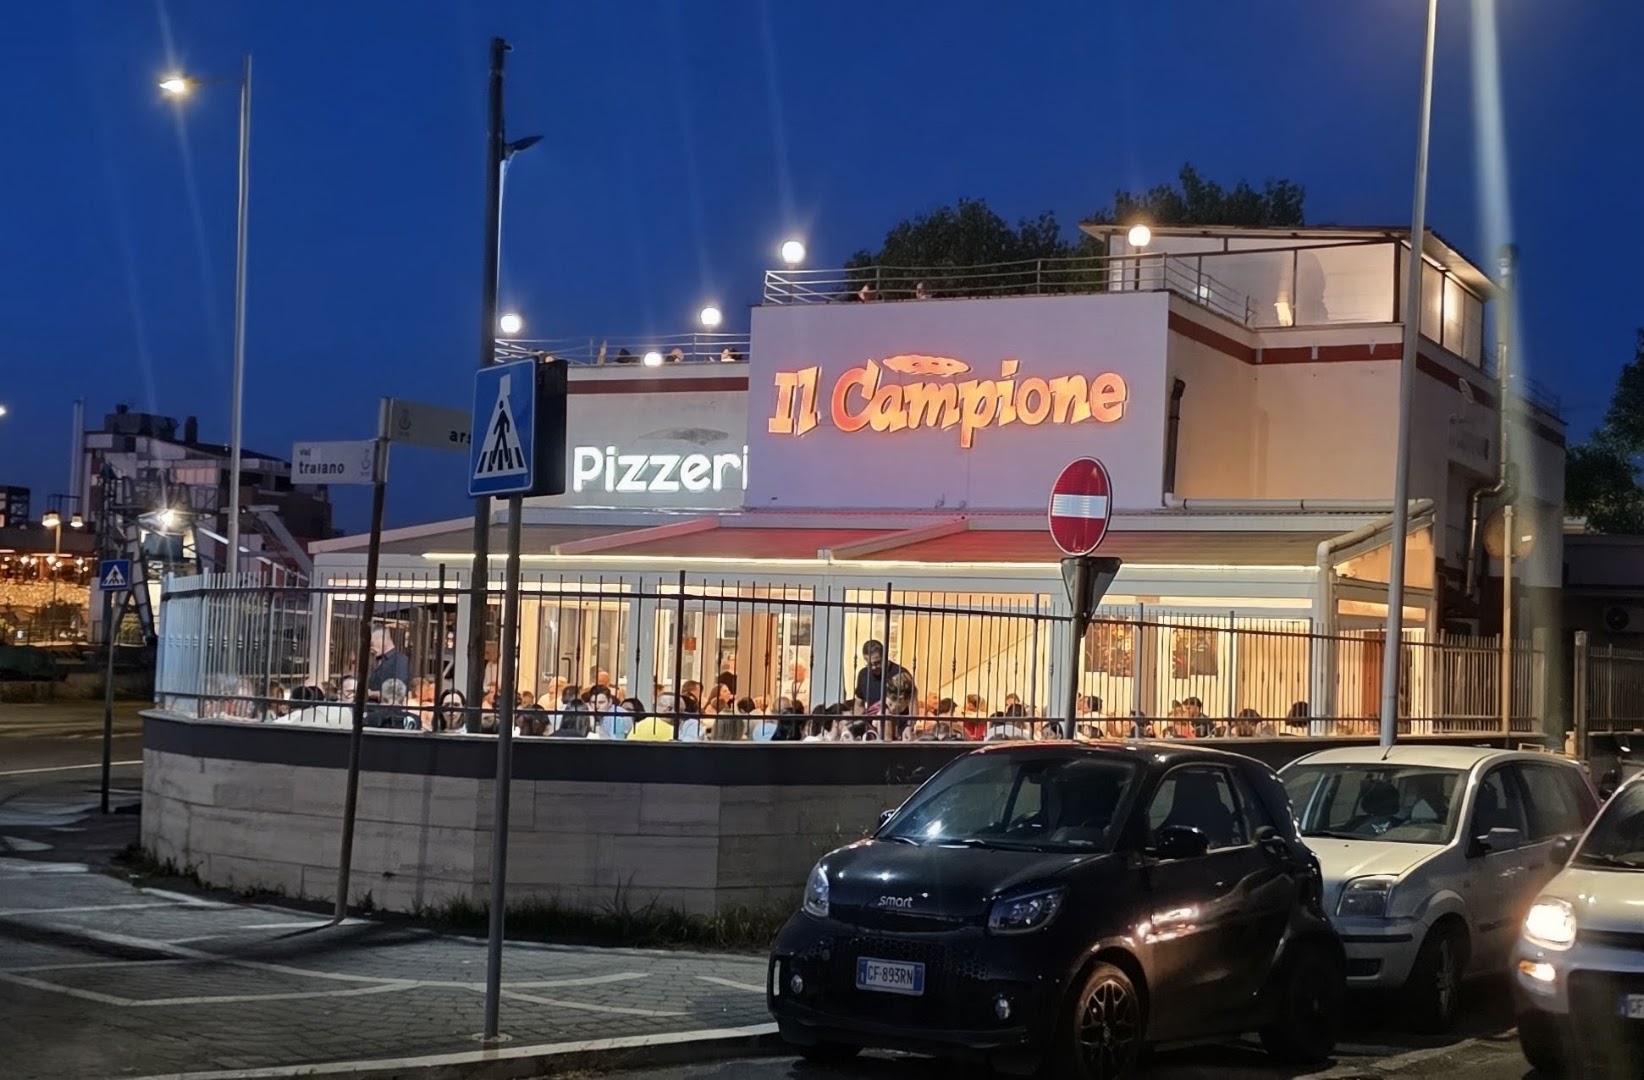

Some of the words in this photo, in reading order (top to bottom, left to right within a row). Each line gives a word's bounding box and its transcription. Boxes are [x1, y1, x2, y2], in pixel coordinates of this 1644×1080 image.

[768, 366, 820, 436] Il
[831, 358, 1128, 449] Campione
[299, 461, 345, 475] traiano
[878, 896, 913, 908] smart
